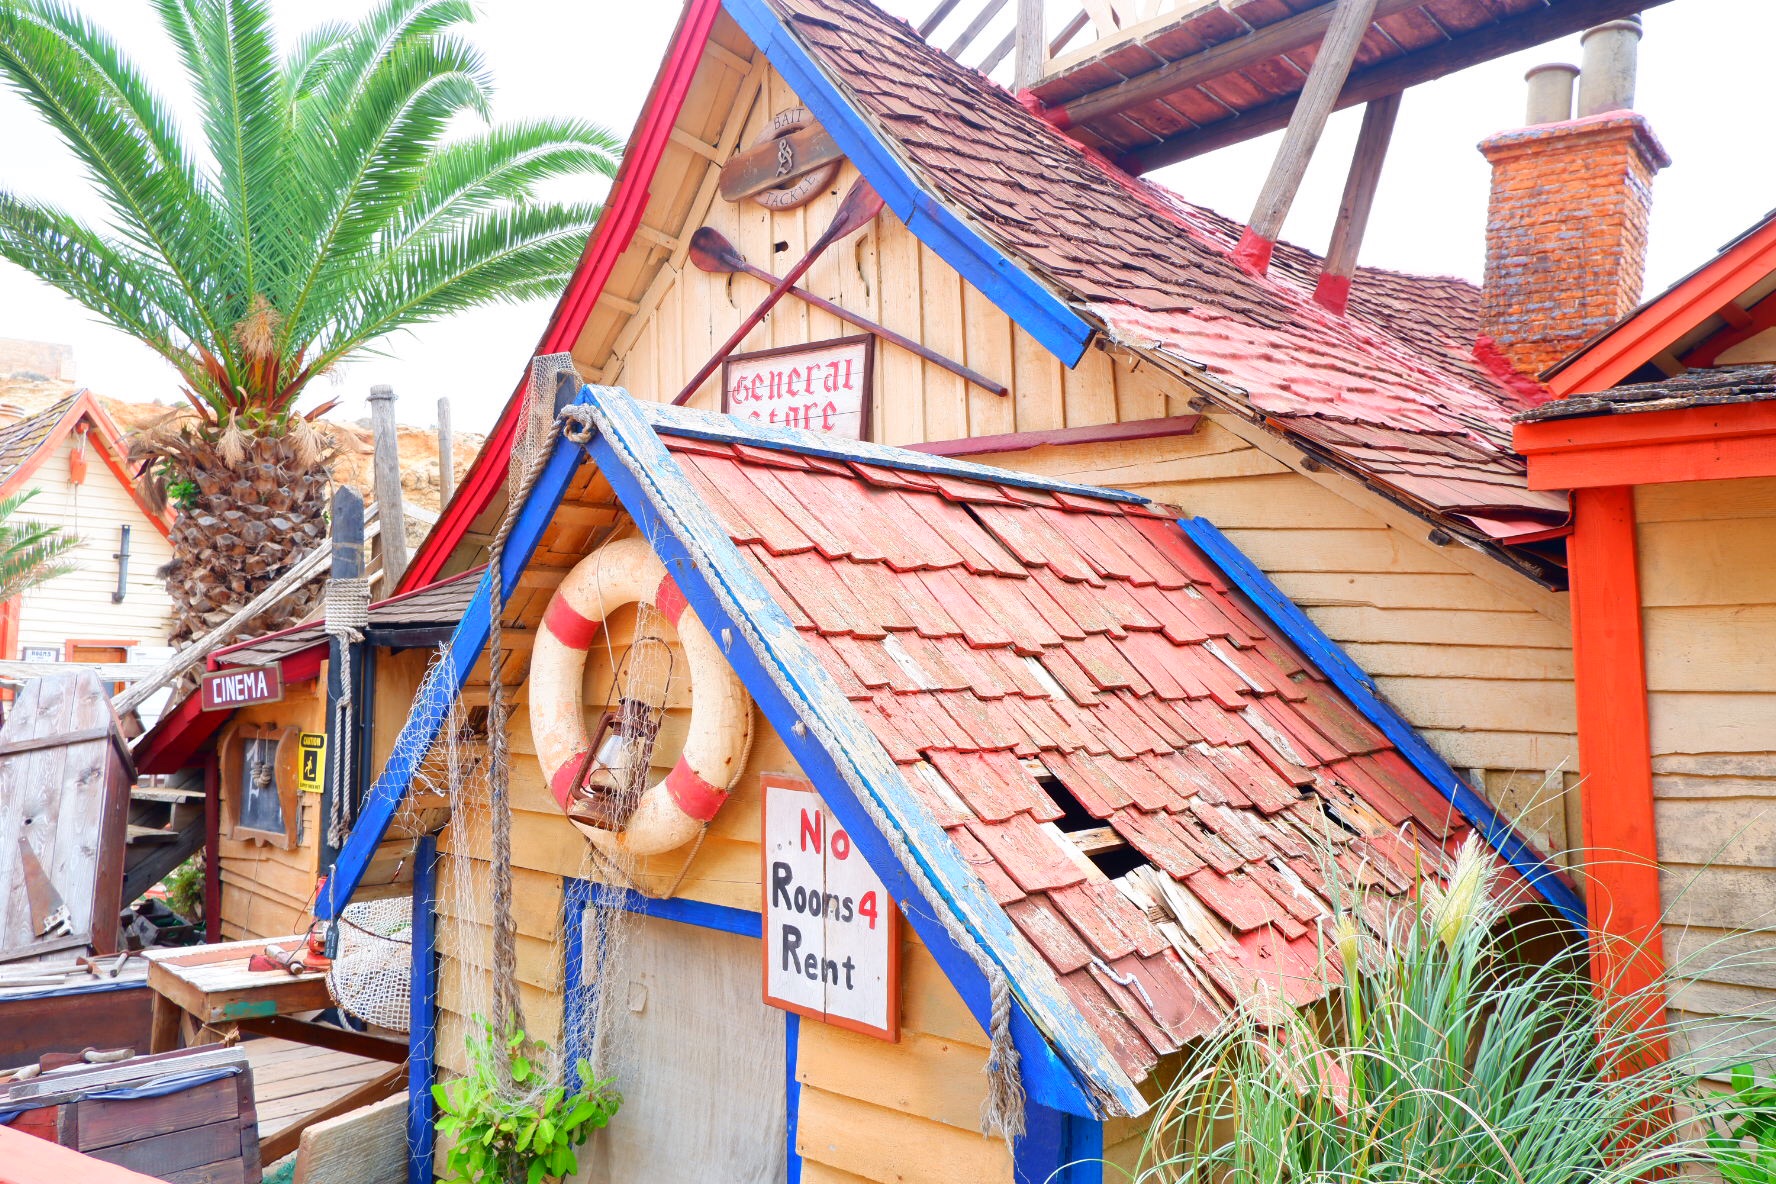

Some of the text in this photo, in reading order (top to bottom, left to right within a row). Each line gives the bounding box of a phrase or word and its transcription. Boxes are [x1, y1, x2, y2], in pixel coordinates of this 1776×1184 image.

[773, 108, 804, 130] BAIT
[765, 176, 816, 207] TACKLE
[732, 359, 854, 404] General
[213, 671, 268, 704] CINEMA
[801, 808, 850, 861] No
[772, 861, 878, 930] Rooms 4
[782, 924, 856, 991] Rent
